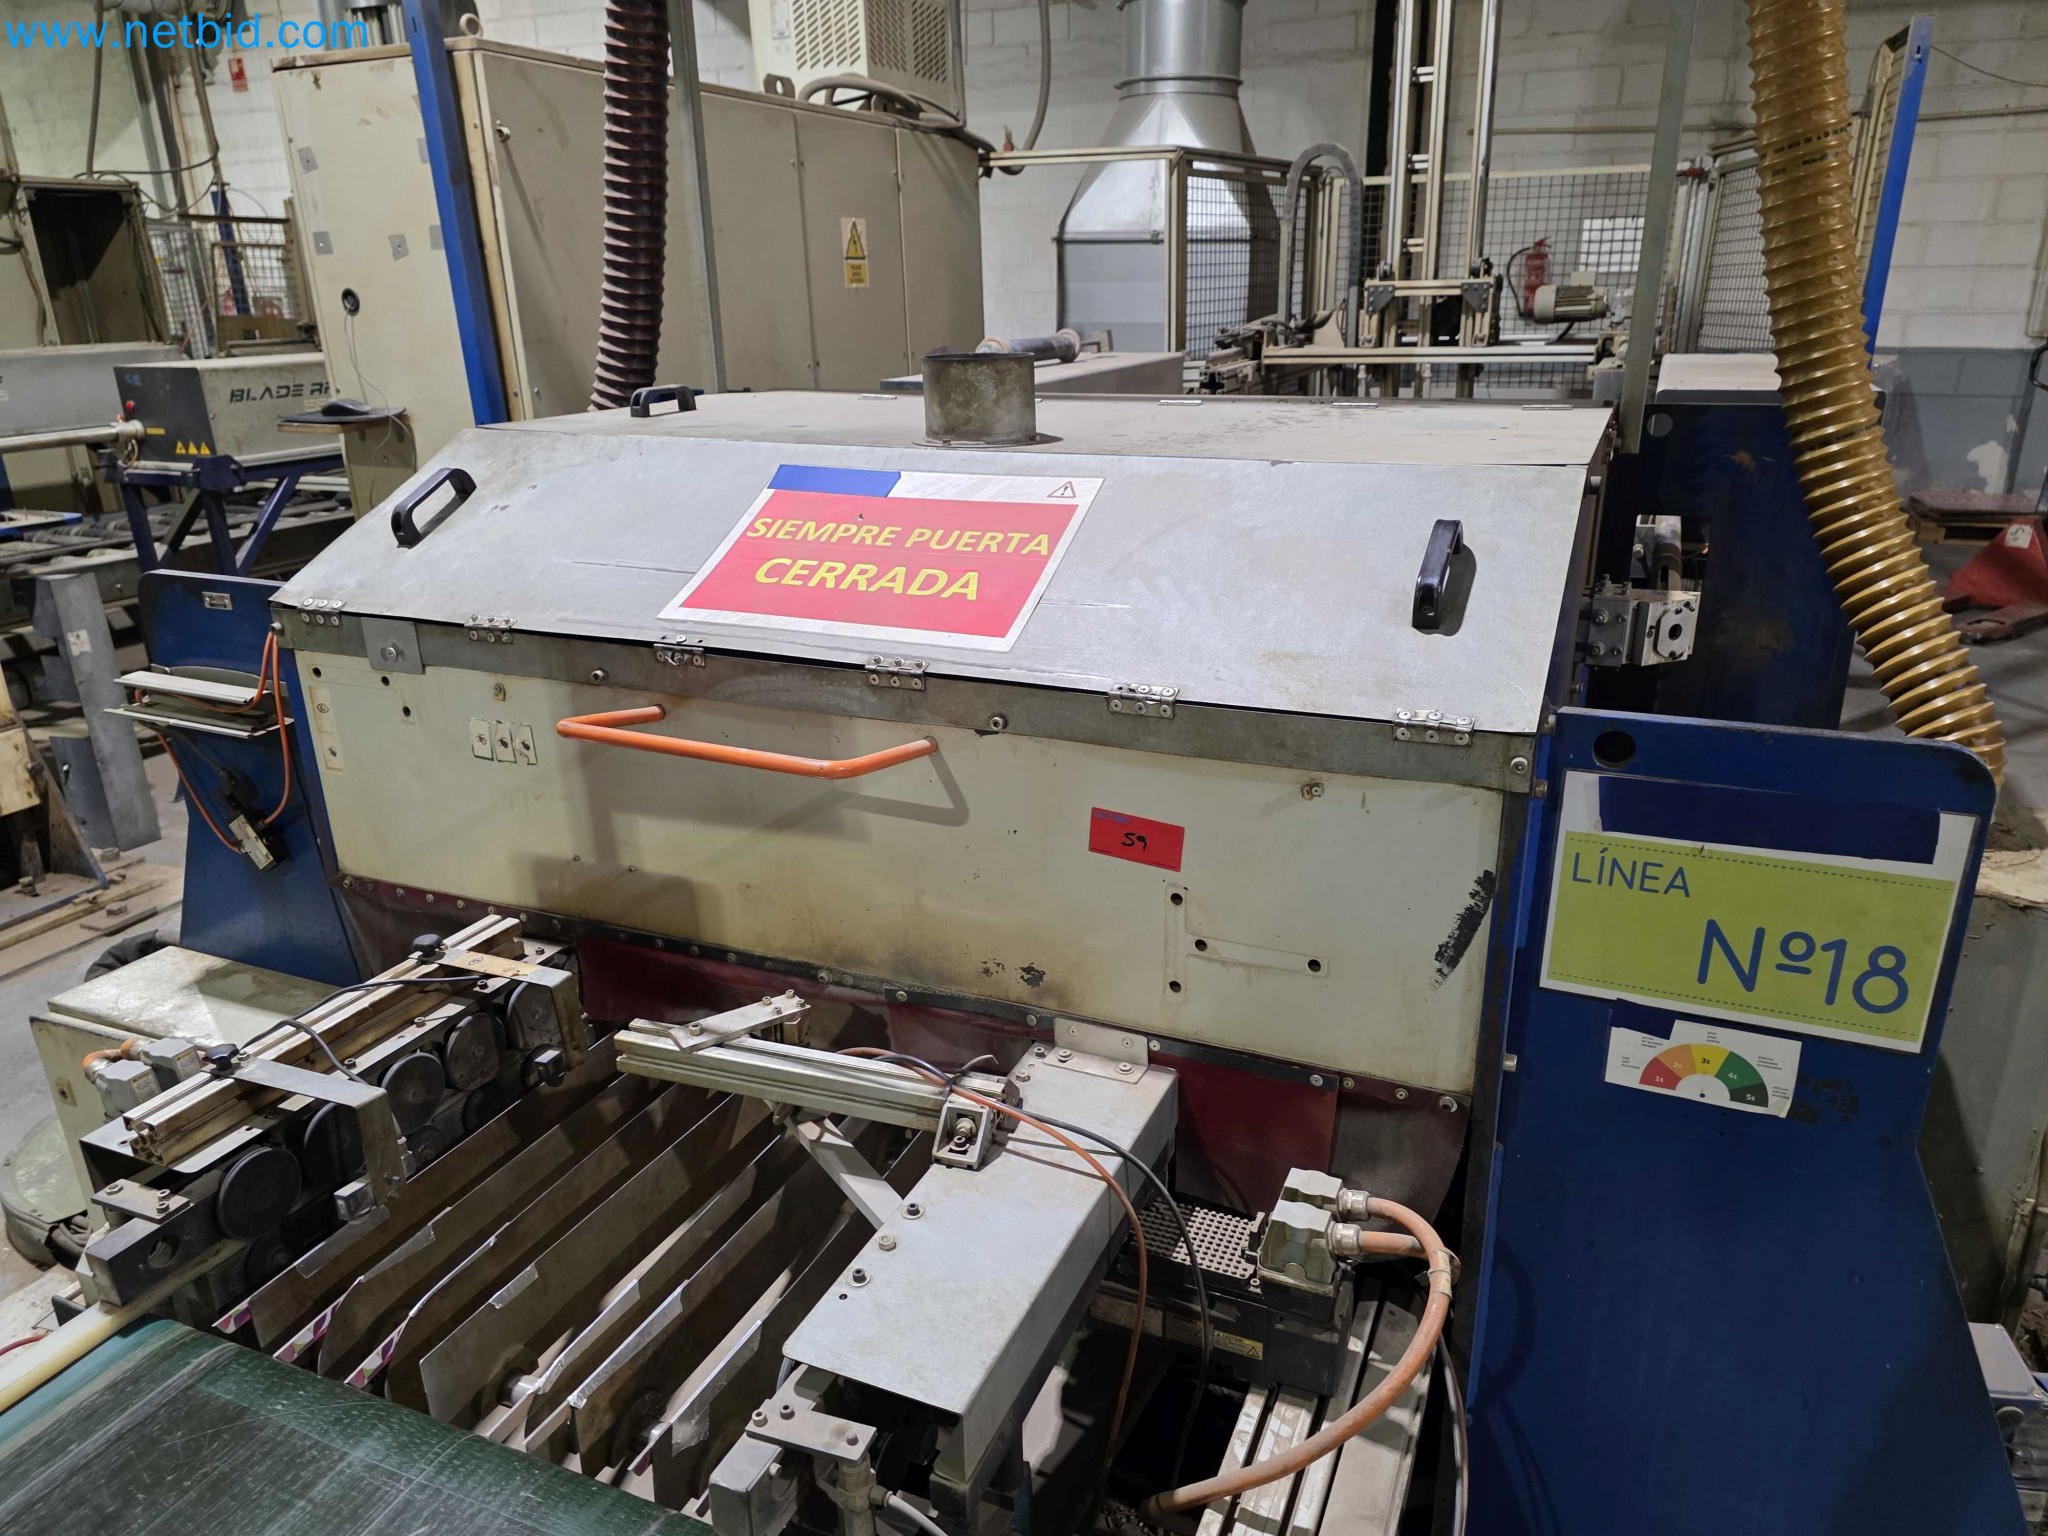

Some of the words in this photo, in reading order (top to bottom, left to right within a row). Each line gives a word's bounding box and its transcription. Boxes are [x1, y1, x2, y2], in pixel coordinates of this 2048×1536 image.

[229, 383, 305, 404] BLADE
[746, 517, 901, 548] SIEMPRE
[905, 528, 1050, 556] PUERTA
[754, 557, 980, 601] CERRADA
[1571, 847, 1691, 899] LÍNEA
